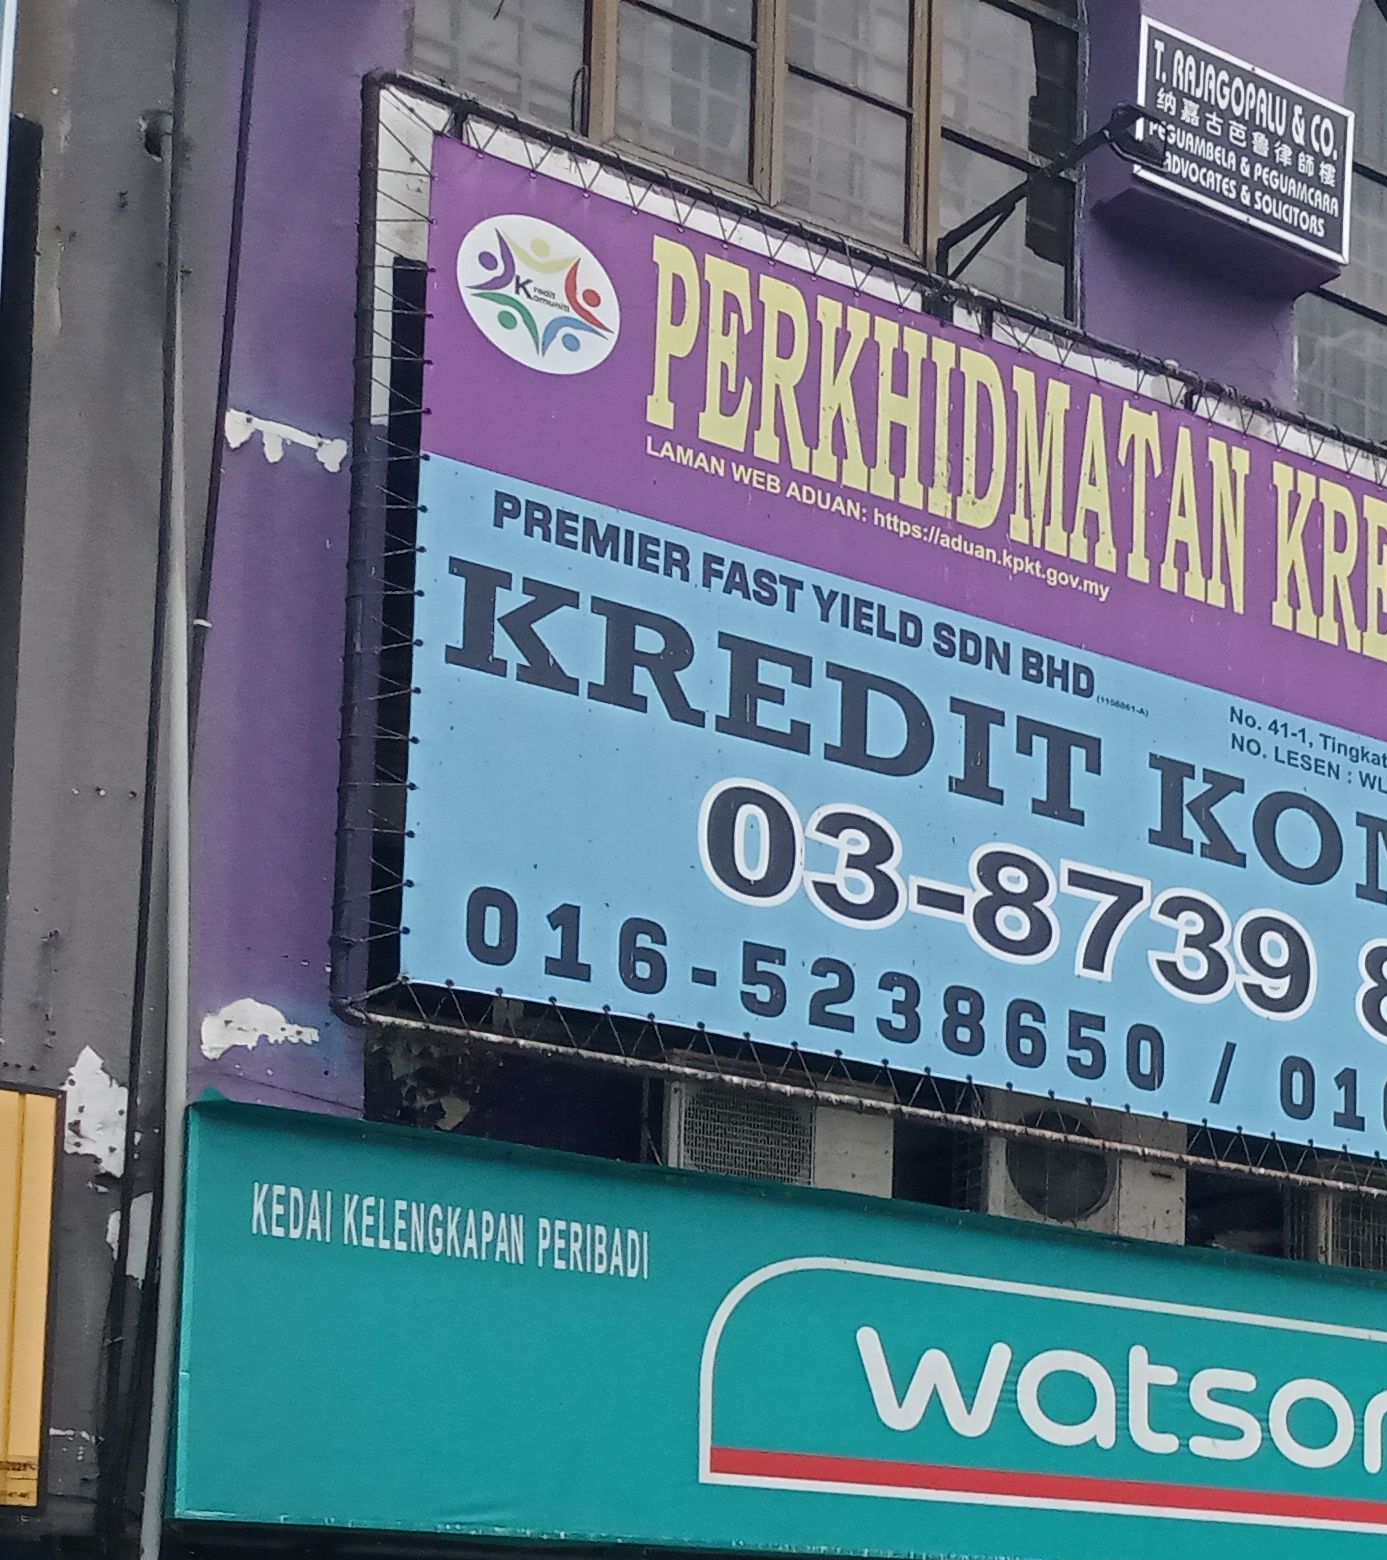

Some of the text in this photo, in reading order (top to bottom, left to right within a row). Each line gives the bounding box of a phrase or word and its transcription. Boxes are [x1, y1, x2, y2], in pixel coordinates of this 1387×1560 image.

[1153, 39, 1338, 160] T. RAJAGOPALU & CO.
[1163, 151, 1325, 238] ADVOCATES & SOLICITORS
[1239, 156, 1251, 178] &
[1253, 163, 1339, 218] PEGUAMCARA
[646, 235, 1252, 615] PERKHIDMATAN
[646, 436, 1110, 602] LAMAN WEB ADUAN: https://aduan.kpkt.gov.my
[493, 490, 1096, 700] PREMIER FAST YIELD SDN BHD
[444, 556, 1102, 827] KREDIT
[1230, 705, 1265, 734] No.
[1267, 716, 1314, 749] 41-1,
[1319, 730, 1387, 774] Tingkat
[1230, 734, 1269, 764] NO.
[1272, 745, 1341, 784] LESEN
[702, 778, 1318, 1022] 03-8739
[466, 886, 1166, 1092] 016-5238650
[251, 1181, 649, 1280] KEDAI KELENGKAPAN PERIBADI
